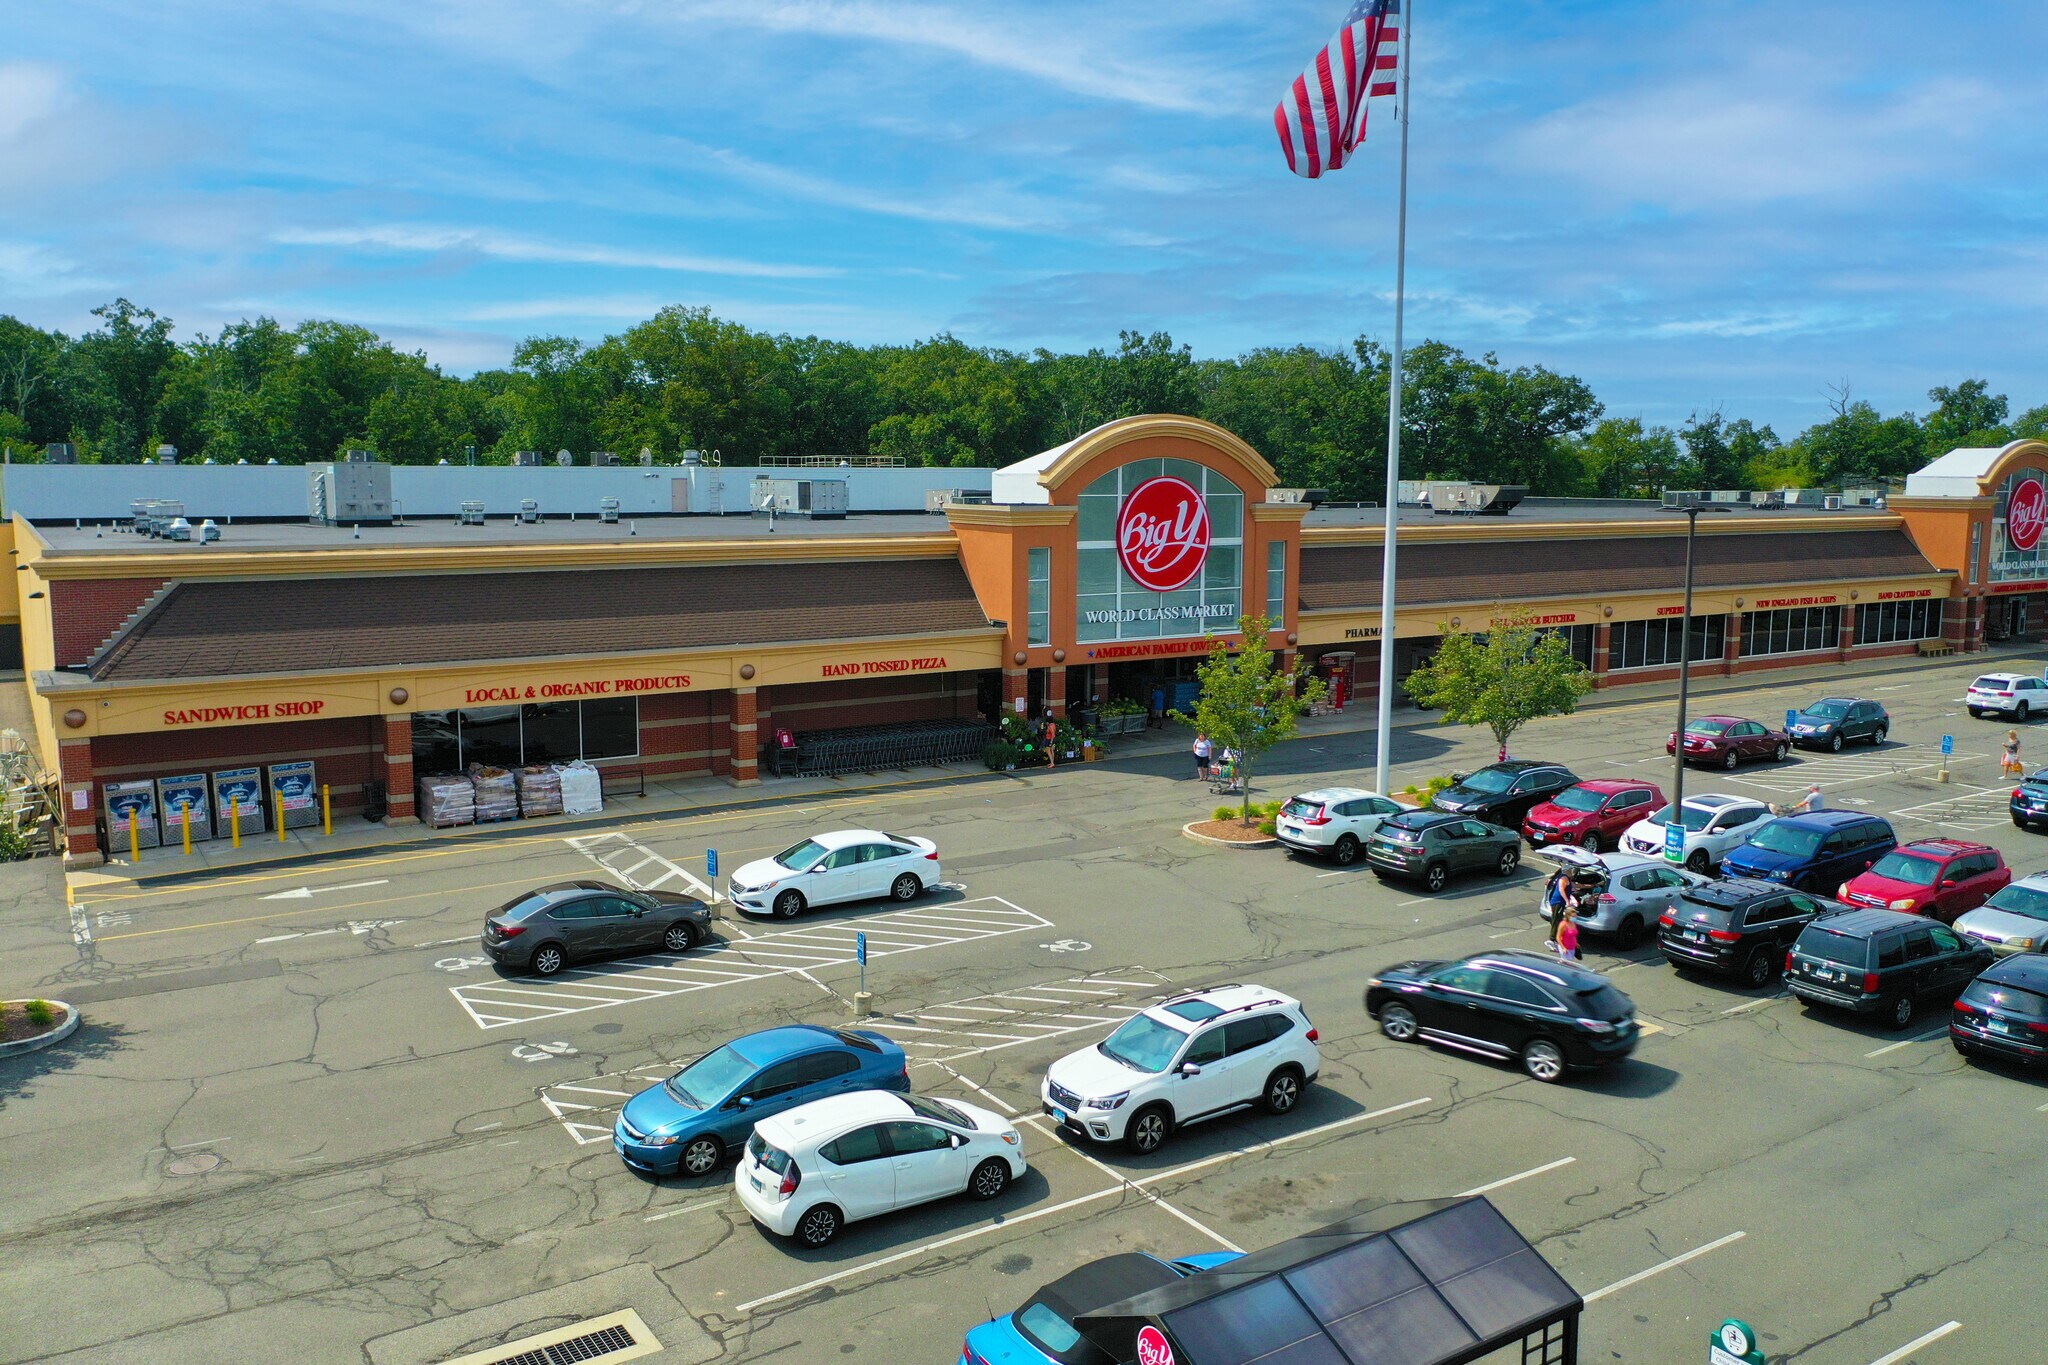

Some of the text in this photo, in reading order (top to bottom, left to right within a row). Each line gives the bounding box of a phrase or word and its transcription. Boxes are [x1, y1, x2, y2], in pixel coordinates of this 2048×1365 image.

[1123, 512, 1172, 564] Big
[2012, 560, 2029, 570] CLASS
[1756, 600, 1770, 608] NEW
[1771, 598, 1799, 607] ENGLAND
[1800, 597, 1813, 605] FISH
[1819, 595, 1837, 603] CHIPS
[1877, 589, 1932, 600] HAND CRAFTED CAKES
[1085, 603, 1235, 624] WORLD CLASS MARKET
[1542, 613, 1576, 624] BUTCHER
[1094, 644, 1150, 659] AMERICAN
[1152, 641, 1189, 656] FAMILY
[822, 657, 947, 677] HAND TOSSED PIZZA
[465, 675, 691, 703] LOCAL & ORGANIC PRODUCTS
[164, 700, 324, 725] SANDWICH SHOP
[1139, 1337, 1159, 1365] Big
